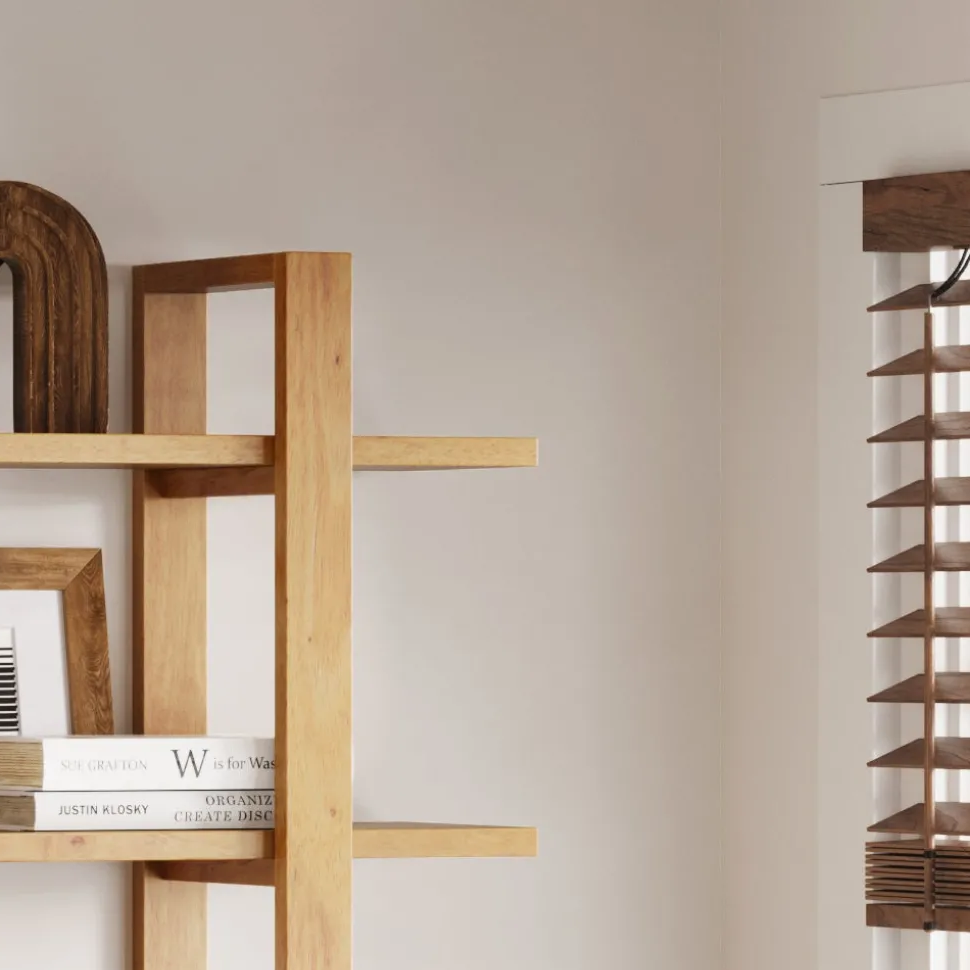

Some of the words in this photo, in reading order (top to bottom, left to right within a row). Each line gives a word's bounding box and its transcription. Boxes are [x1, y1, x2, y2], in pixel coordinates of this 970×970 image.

[87, 758, 148, 771] GRAFTON
[170, 749, 210, 778] W
[213, 757, 224, 770] is
[227, 756, 246, 770] for
[205, 794, 273, 806] ORGANIZ
[58, 804, 98, 816] JUSTIN
[102, 804, 149, 816] KLOSKY
[174, 810, 233, 822] CREATE
[237, 810, 273, 822] DISC
